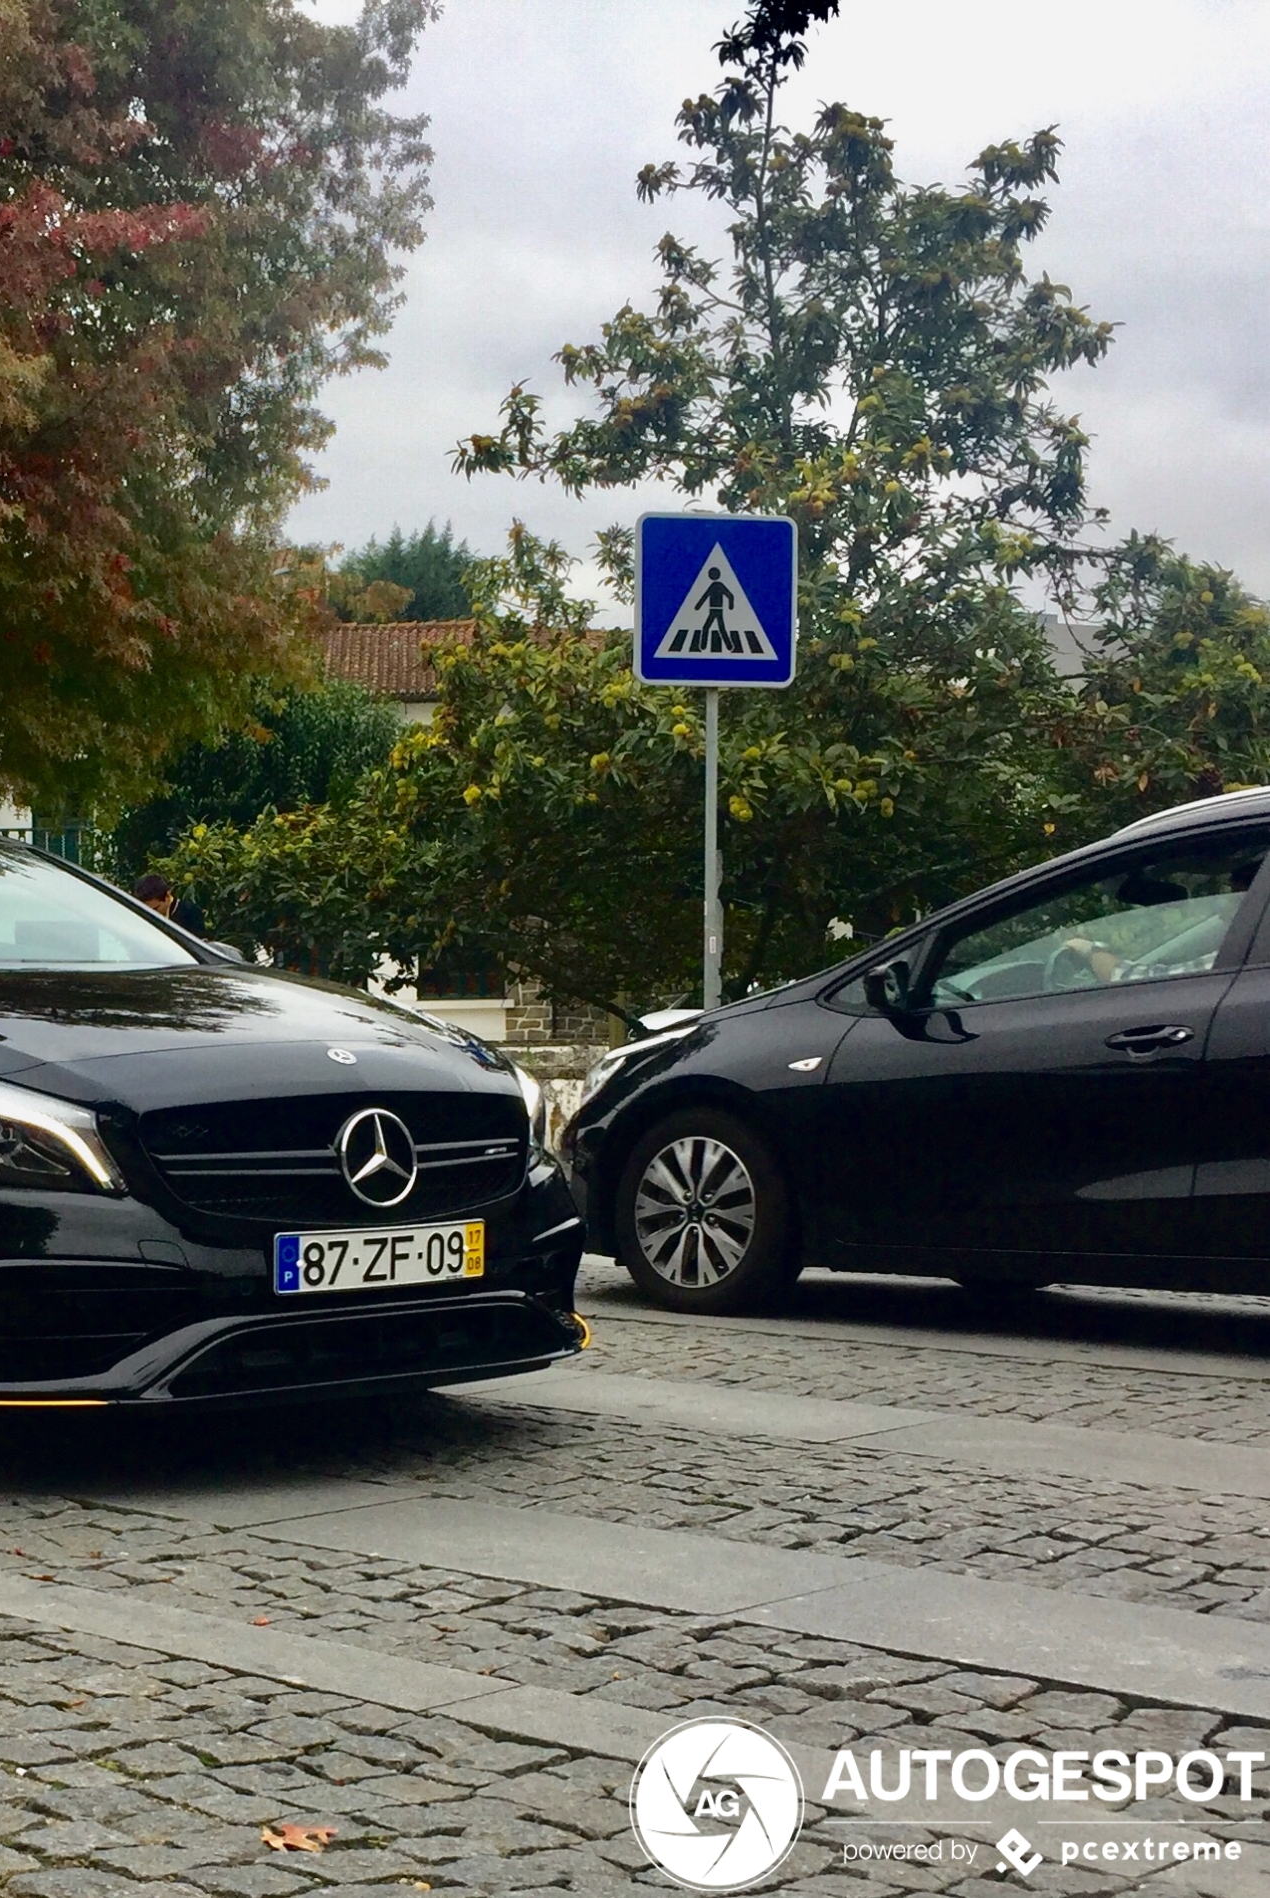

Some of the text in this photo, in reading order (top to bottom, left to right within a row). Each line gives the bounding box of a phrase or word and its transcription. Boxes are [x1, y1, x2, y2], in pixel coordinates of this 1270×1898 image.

[468, 1230, 482, 1244] 17
[467, 1256, 482, 1271] 08
[284, 1271, 293, 1283] P
